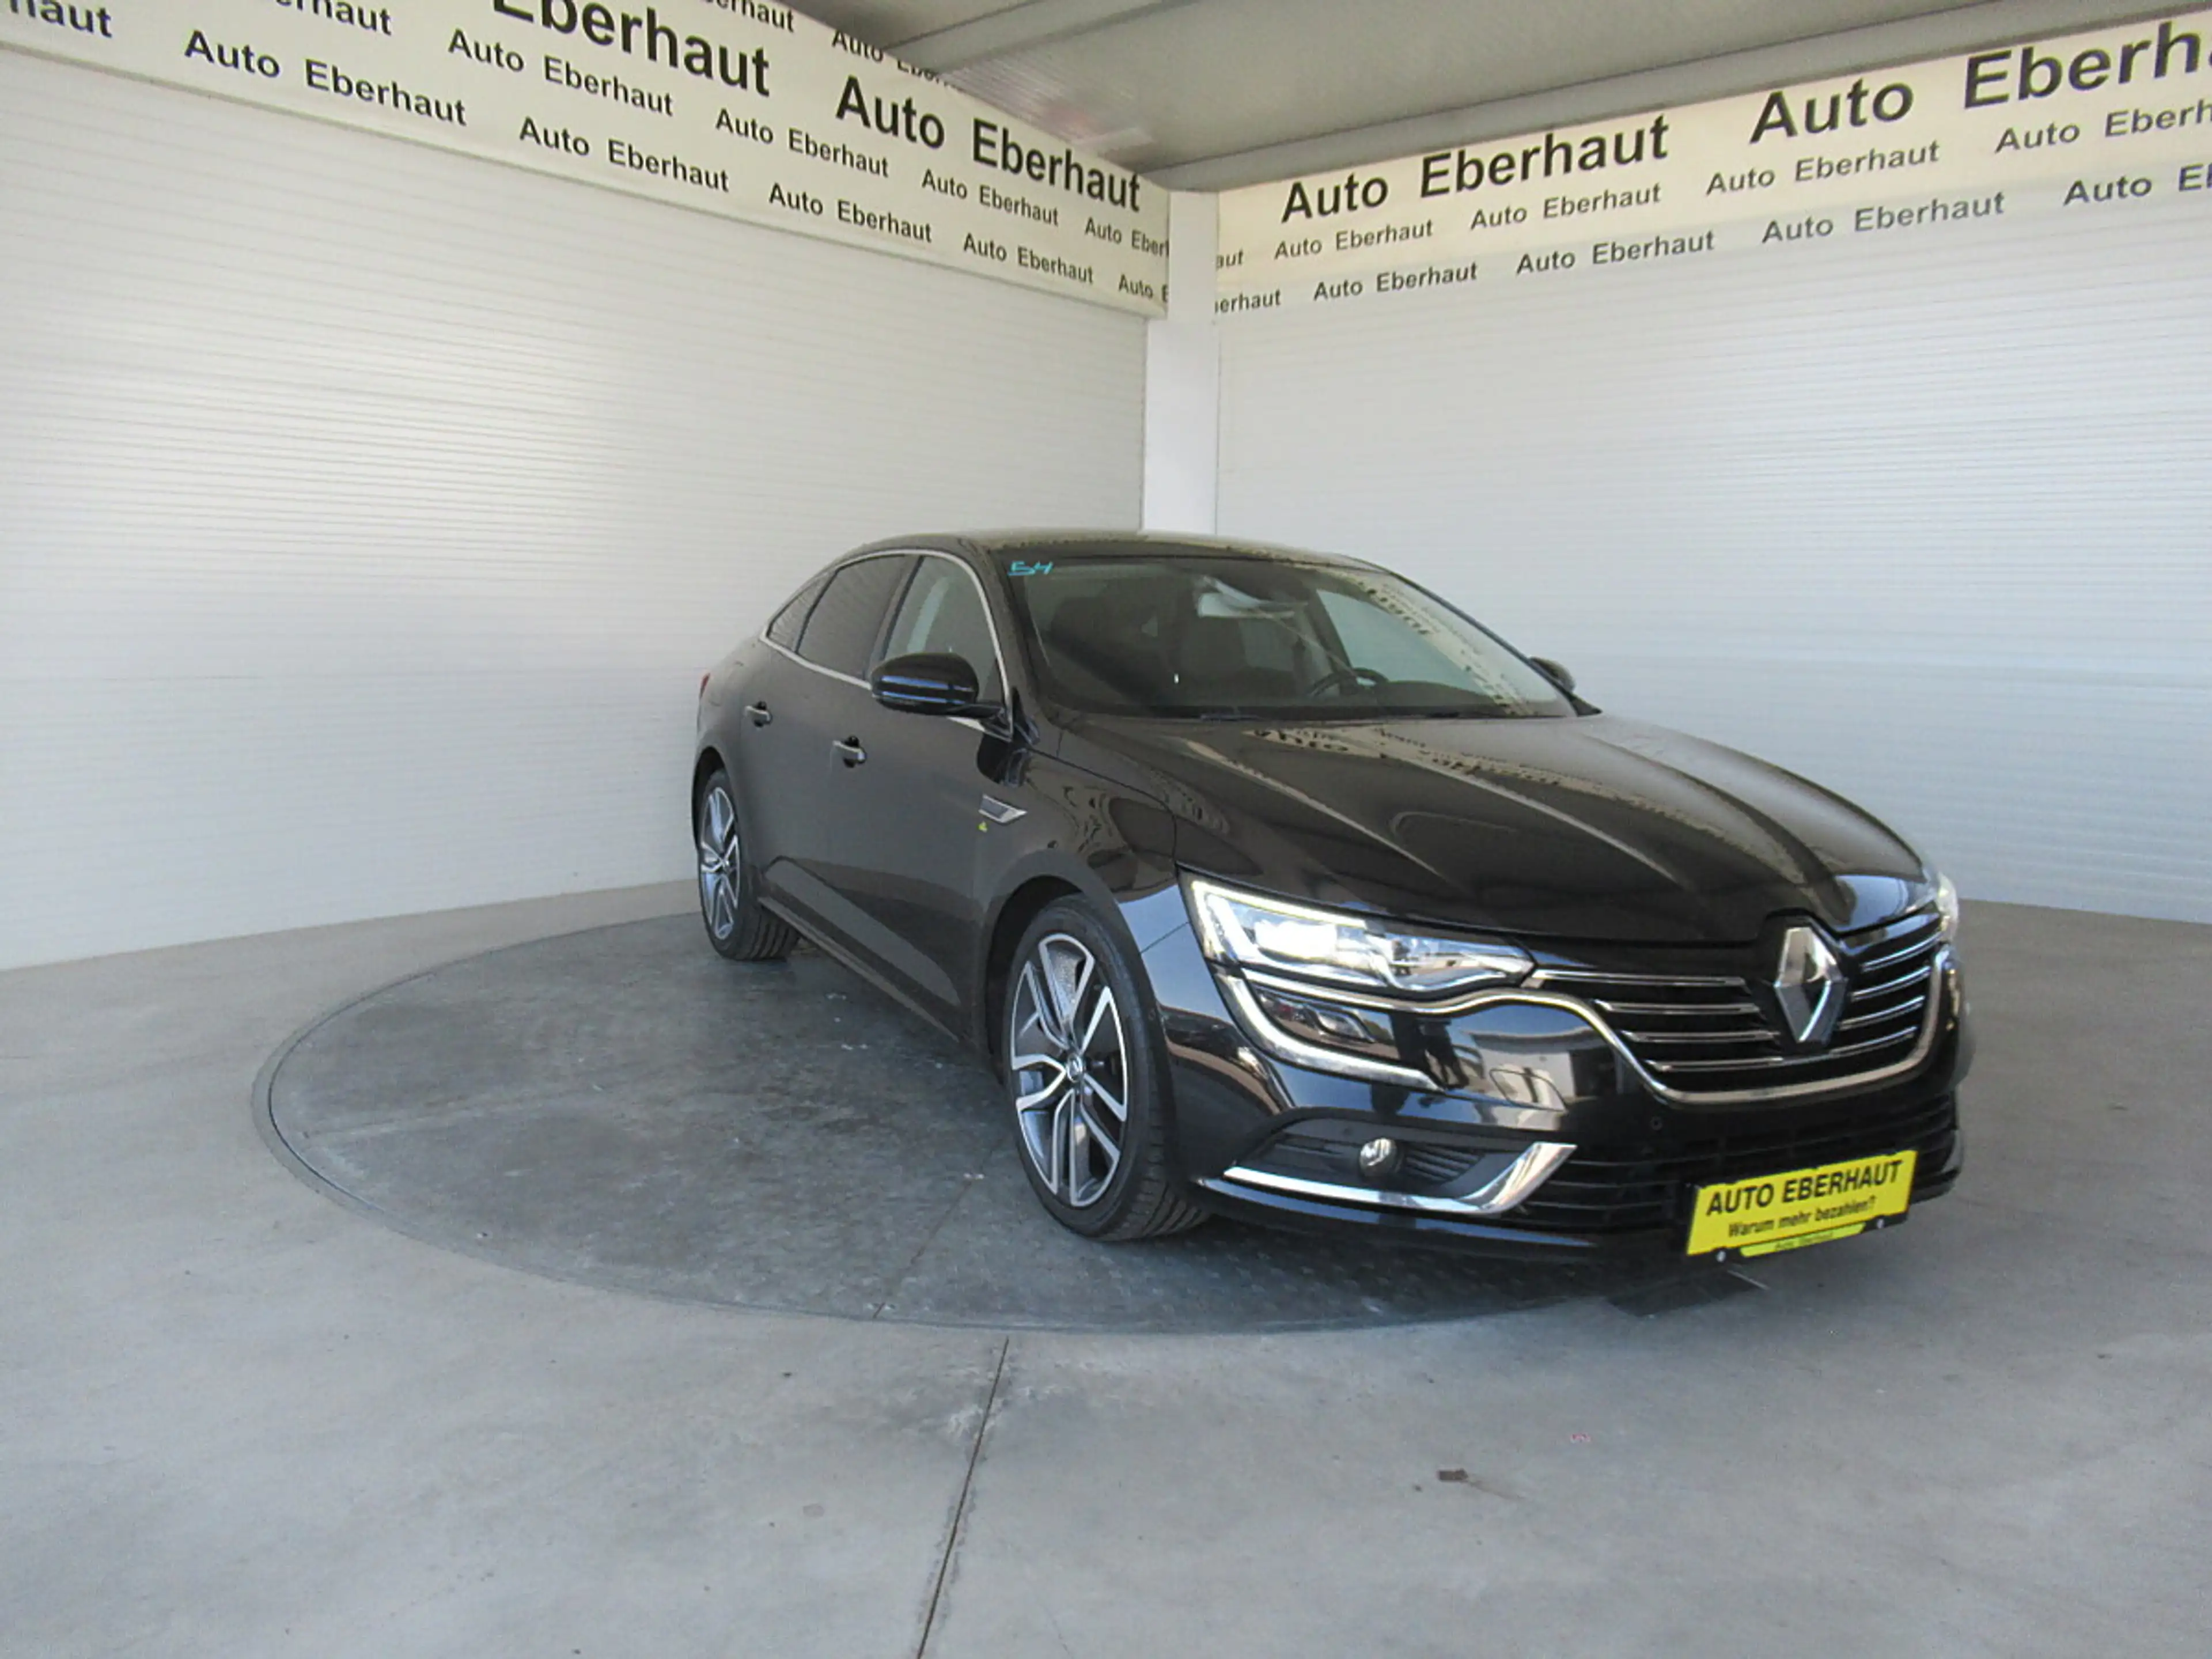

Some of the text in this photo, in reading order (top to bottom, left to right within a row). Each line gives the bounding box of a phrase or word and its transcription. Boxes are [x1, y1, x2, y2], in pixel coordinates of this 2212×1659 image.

[183, 29, 281, 79] Auto
[305, 58, 467, 127] Eberhaut
[518, 116, 590, 157] Auto
[608, 138, 730, 192] Eberhaut
[768, 182, 824, 217] Auto
[837, 199, 933, 244] Eberhaut
[963, 232, 1008, 262] Auto
[1017, 246, 1094, 285] Eberhaut
[1118, 274, 1154, 301] Auto
[448, 28, 524, 73] Auto
[544, 55, 673, 118] Eberhaut
[715, 108, 774, 145] Auto
[789, 127, 889, 178] Eberhaut
[921, 168, 968, 200] Auto
[979, 184, 1059, 226] Eberhaut
[1085, 217, 1123, 244] Auto
[835, 74, 945, 150] Auto
[973, 118, 1141, 212] Eberhaut
[1274, 230, 1323, 260] Auto
[1335, 218, 1434, 252] Eberhaut
[1470, 206, 1528, 231] Auto
[1543, 182, 1661, 219] Eberhaut
[1706, 168, 1776, 196] Auto
[1794, 140, 1940, 183] Eberhaut
[1994, 121, 2081, 154] Auto
[1281, 21, 2212, 225] Auto Eberhaut Auto Eberh
[1313, 279, 1364, 302] Auto
[1376, 262, 1478, 293] Eberhaut
[1516, 251, 1576, 275] Auto
[1592, 230, 1715, 266] Eberhaut
[1762, 219, 1834, 244] Auto
[1854, 191, 2005, 233] Eberhaut
[2063, 176, 2153, 206] Auto
[1706, 1159, 1904, 1217] AUTO EBERHAUT
[1729, 1219, 1775, 1238] Warum
[1778, 1210, 1812, 1228] mehr
